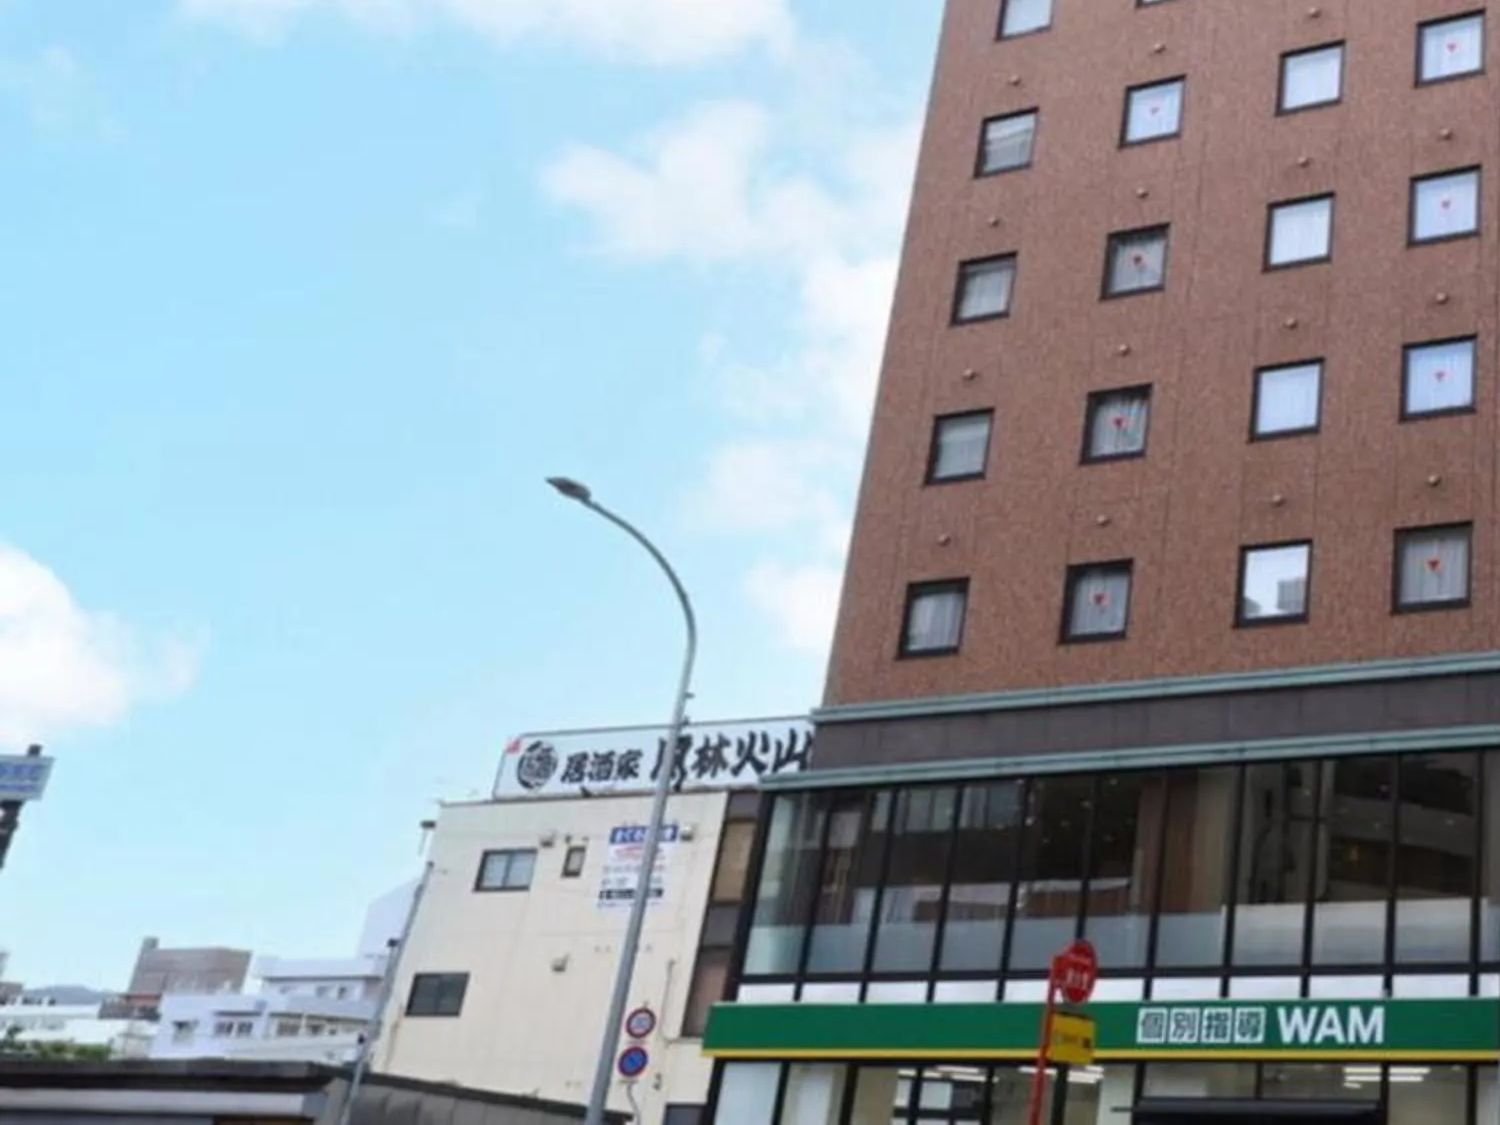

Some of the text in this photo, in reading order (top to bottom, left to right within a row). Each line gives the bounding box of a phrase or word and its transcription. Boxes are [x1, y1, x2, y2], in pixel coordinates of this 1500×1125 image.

[1136, 1007, 1266, 1044] 個別指導
[1277, 1006, 1385, 1044] WAM
